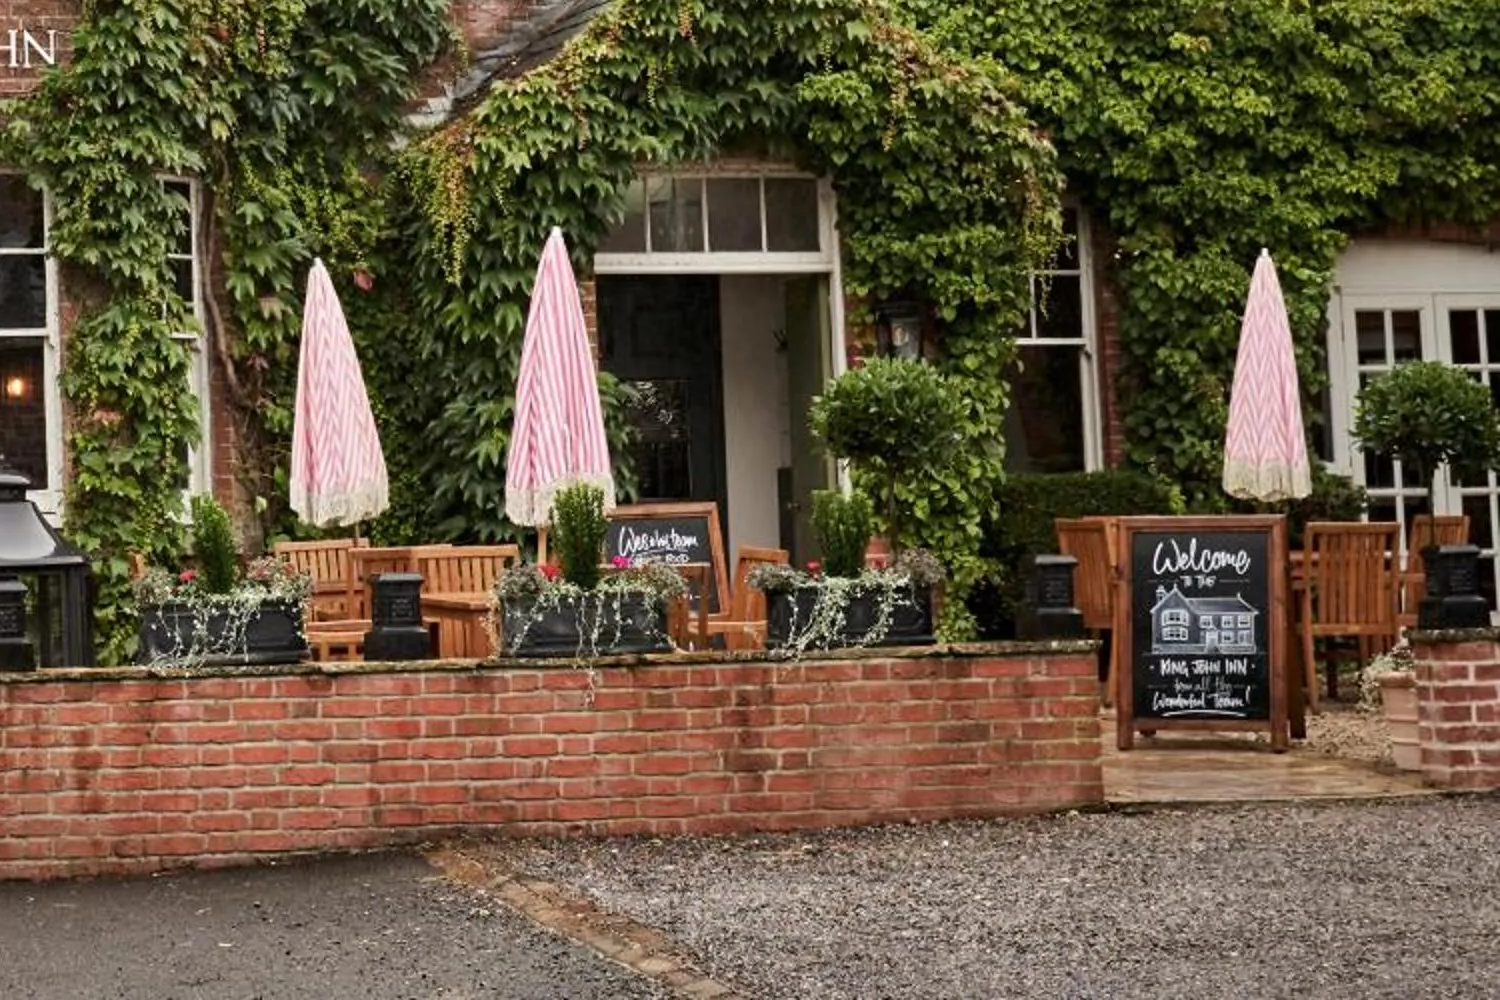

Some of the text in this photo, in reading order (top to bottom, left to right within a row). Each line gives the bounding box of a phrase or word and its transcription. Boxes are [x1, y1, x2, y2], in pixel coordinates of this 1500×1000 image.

[1152, 537, 1251, 575] Welcome
[1160, 657, 1248, 677] KING JOHN INN
